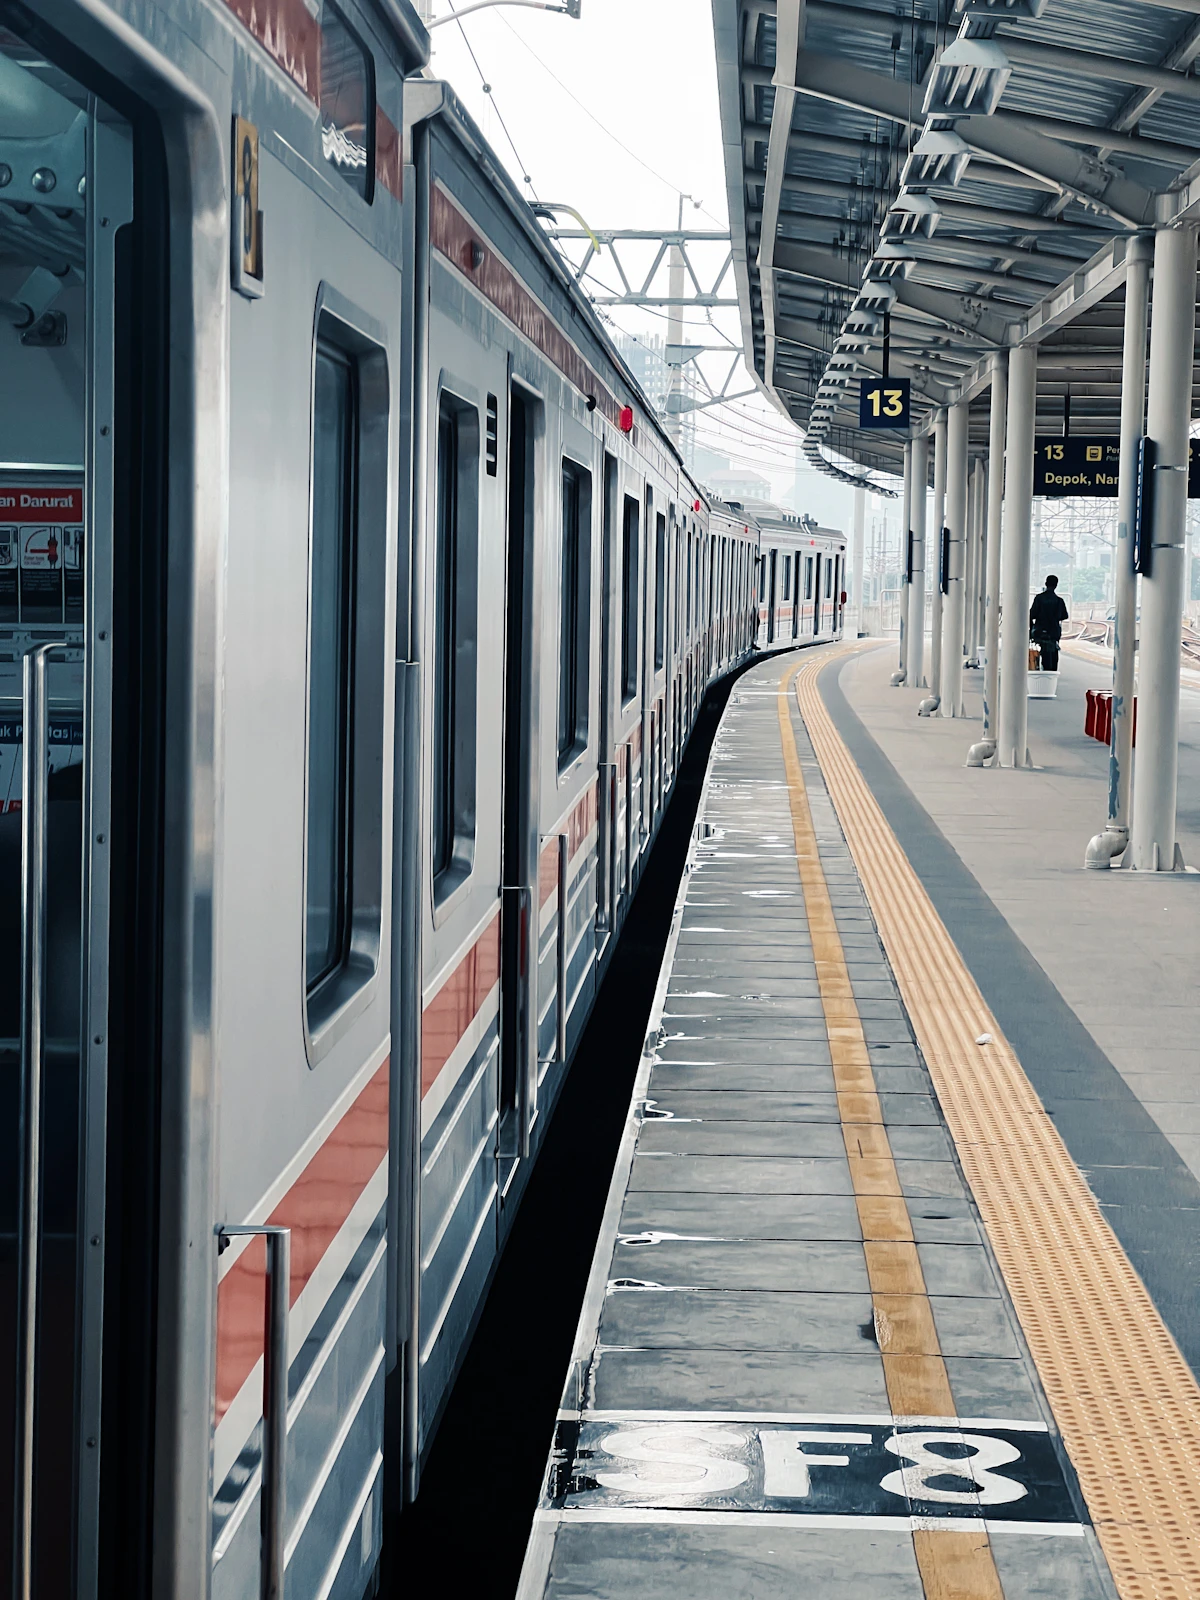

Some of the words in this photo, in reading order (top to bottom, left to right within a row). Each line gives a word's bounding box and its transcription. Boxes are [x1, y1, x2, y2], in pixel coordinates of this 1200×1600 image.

[866, 389, 903, 417] 13
[1044, 444, 1065, 460] 13
[1045, 472, 1091, 486] Depok,
[20, 494, 73, 508] Darurat
[596, 1424, 1029, 1505] SF8
